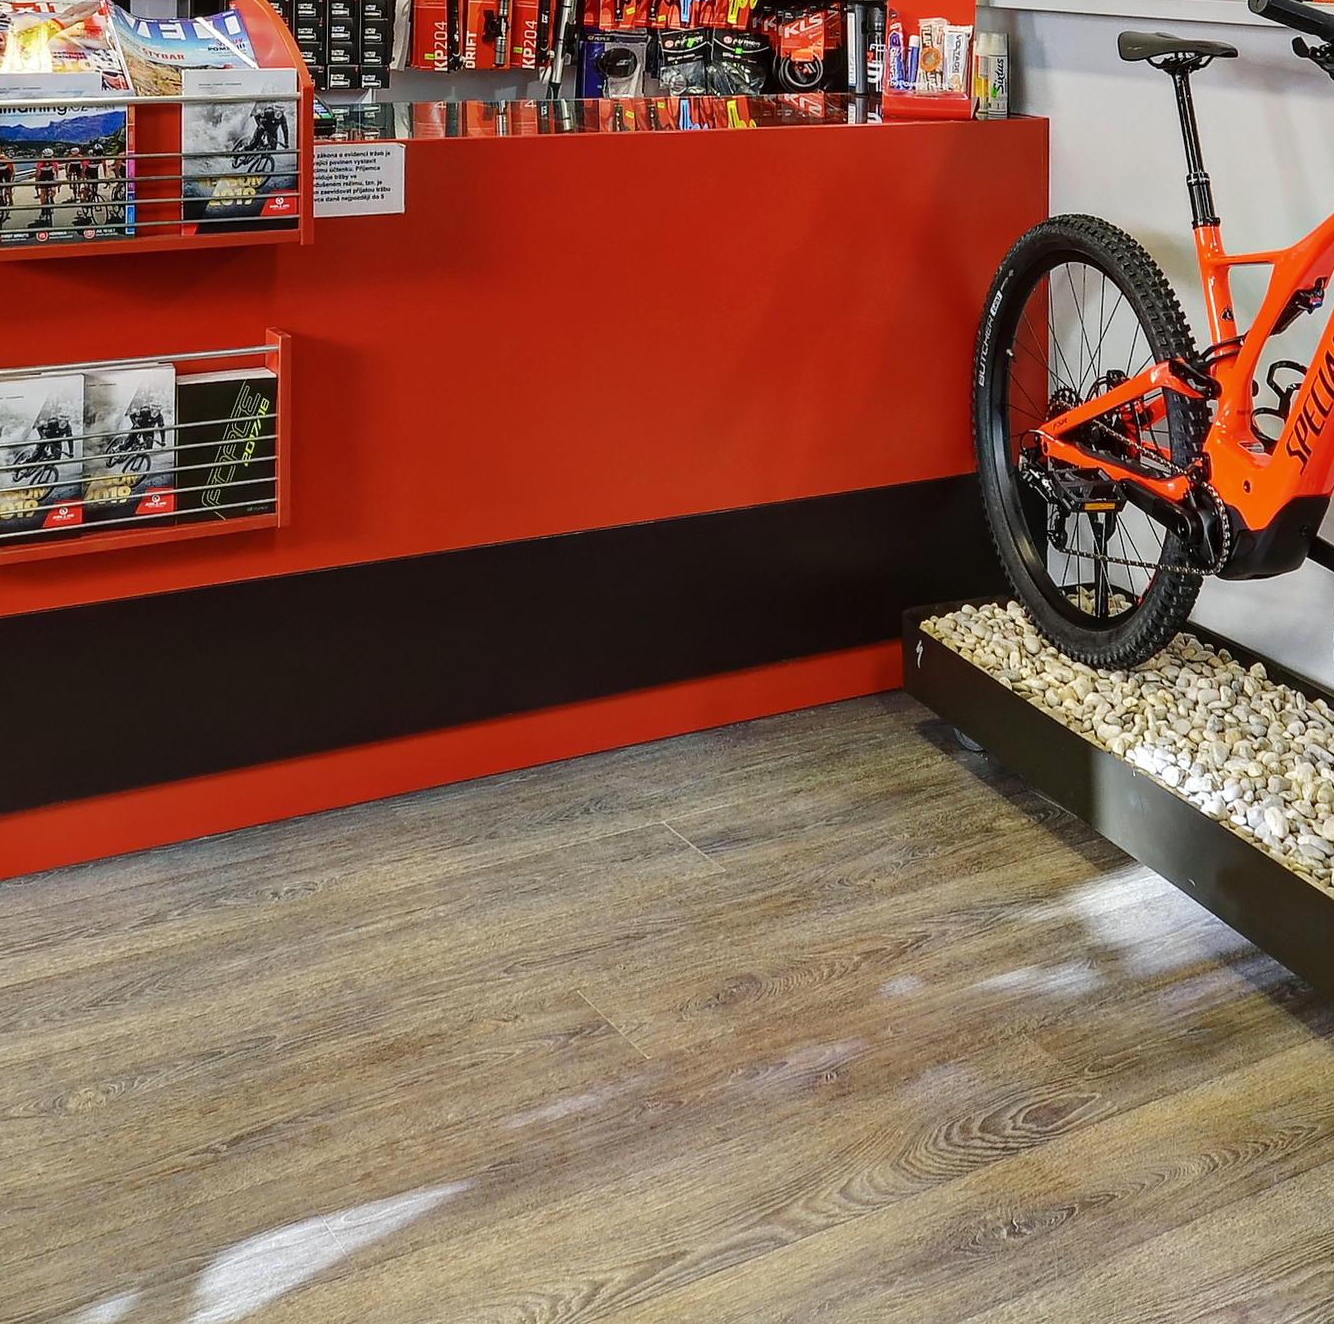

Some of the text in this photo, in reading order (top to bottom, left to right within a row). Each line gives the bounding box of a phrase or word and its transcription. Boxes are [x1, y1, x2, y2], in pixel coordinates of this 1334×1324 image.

[434, 20, 449, 73] KP204
[521, 19, 538, 70] KP204
[784, 14, 824, 39] KLS
[465, 30, 477, 69] DRIFT
[996, 58, 1005, 94] Sixtus
[978, 314, 995, 387] BUTCHER
